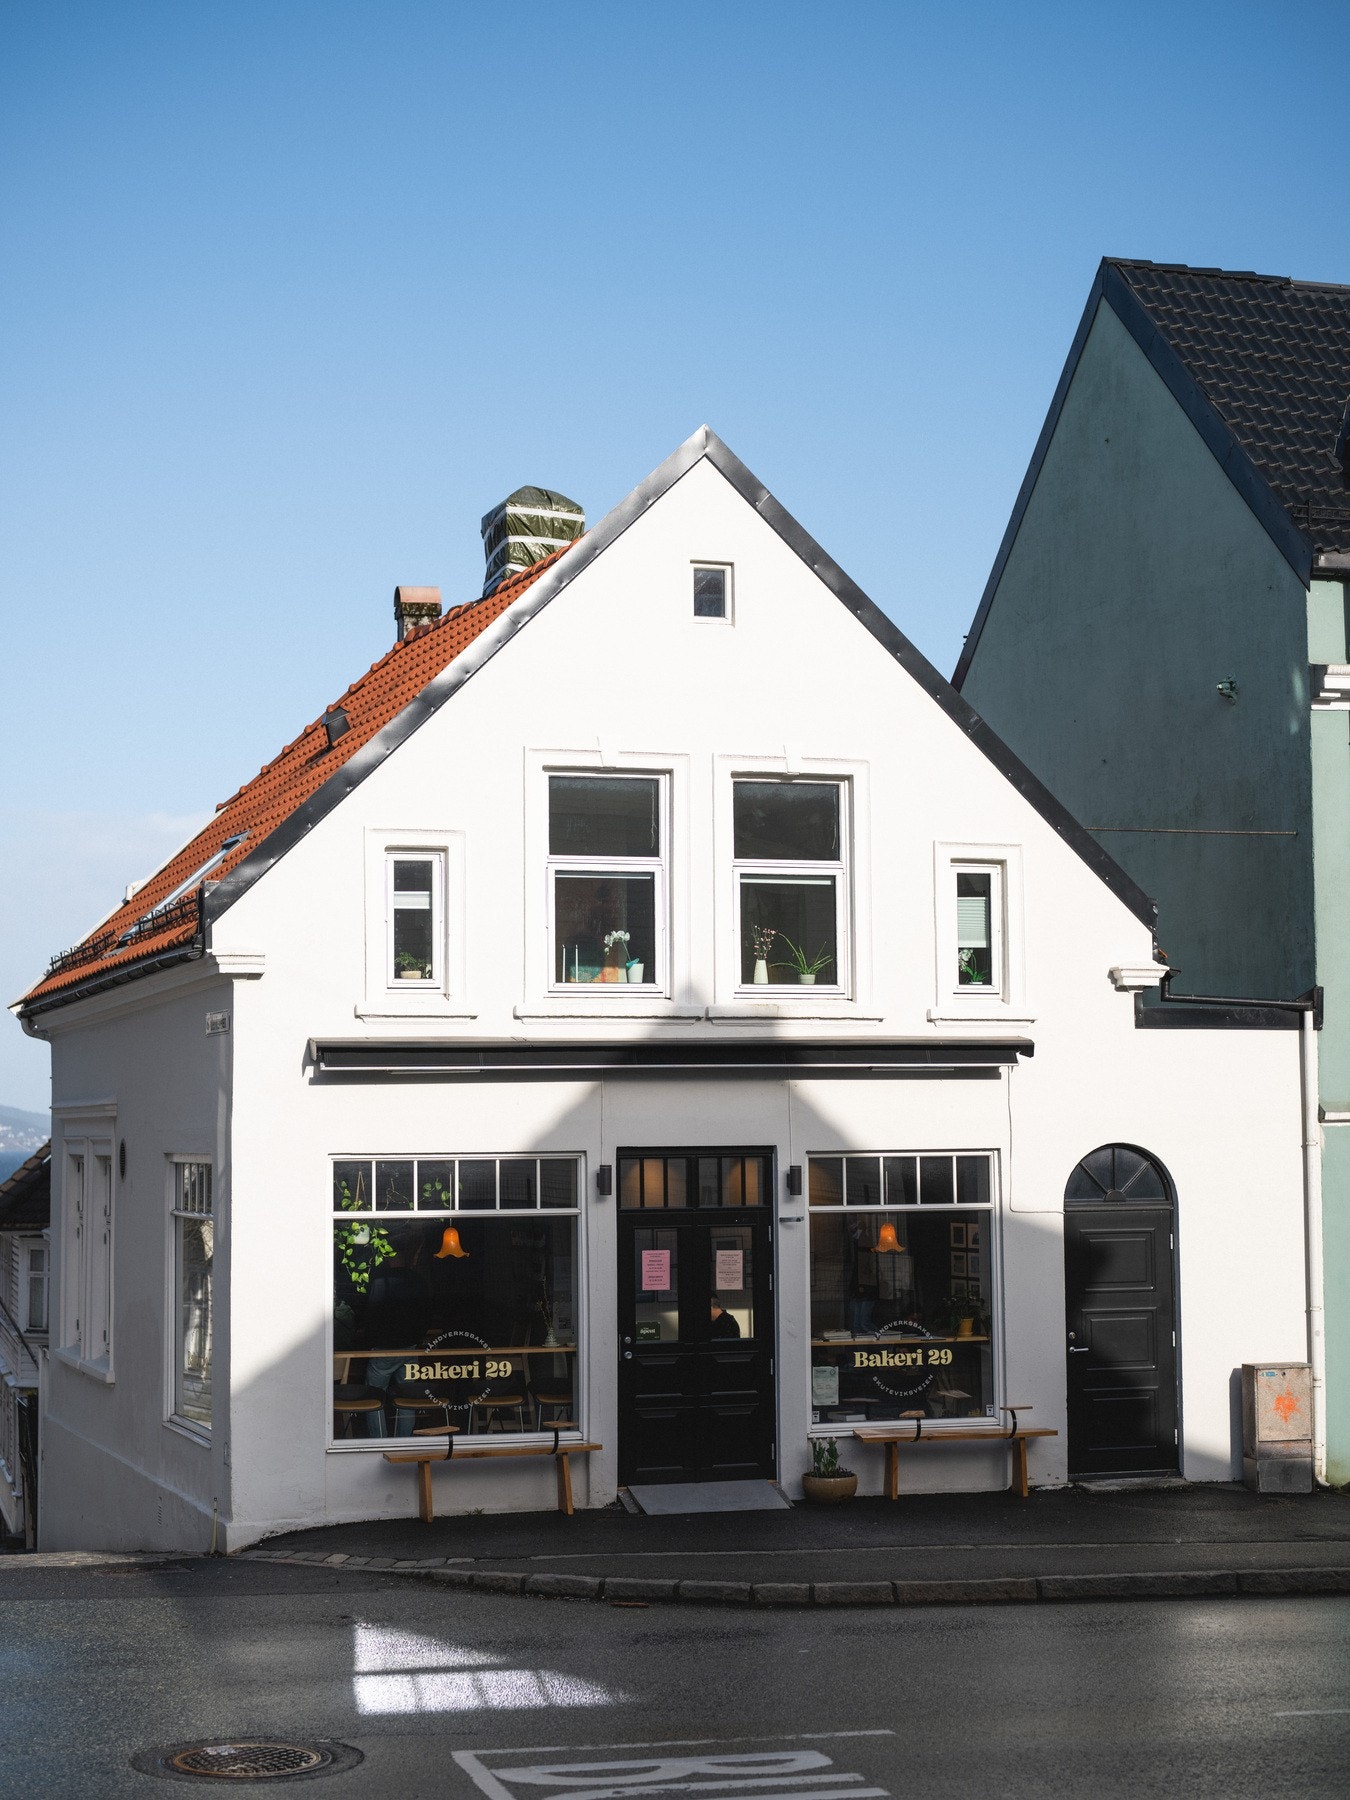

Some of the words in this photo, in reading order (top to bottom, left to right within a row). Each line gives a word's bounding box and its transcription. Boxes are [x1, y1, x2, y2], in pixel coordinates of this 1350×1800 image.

[425, 1330, 491, 1354] HÅNDVERKSBAKST
[853, 1348, 924, 1368] Bakeri
[928, 1348, 953, 1365] 29
[404, 1360, 480, 1381] Bakeri
[485, 1360, 513, 1379] 29
[872, 1374, 934, 1397] SKUTEVIKSVEIEN
[424, 1387, 491, 1411] SKUTEVIKSVEIEN
